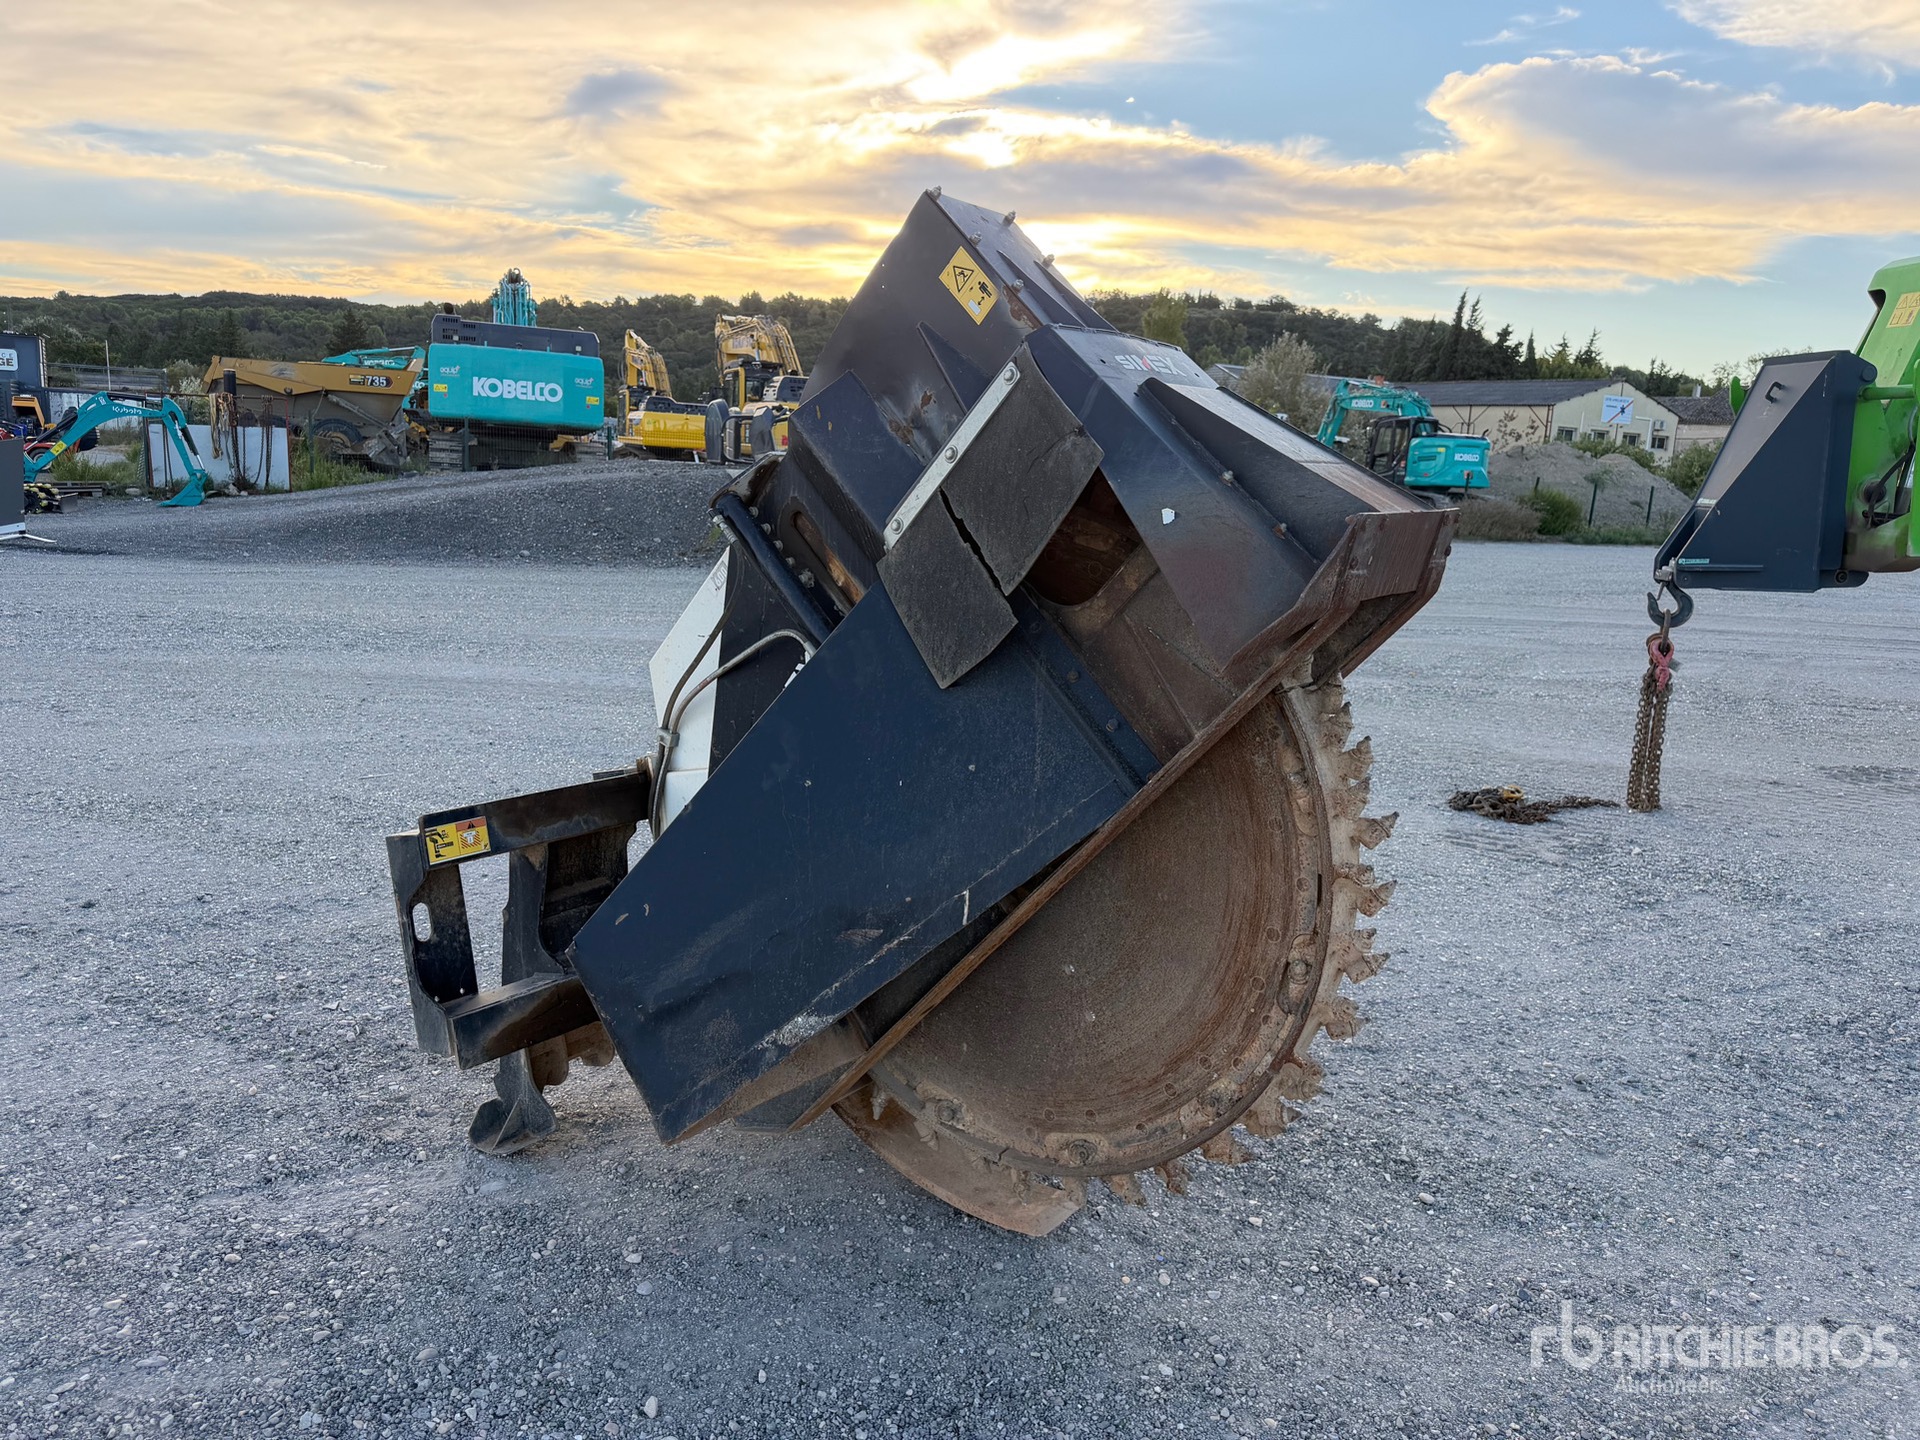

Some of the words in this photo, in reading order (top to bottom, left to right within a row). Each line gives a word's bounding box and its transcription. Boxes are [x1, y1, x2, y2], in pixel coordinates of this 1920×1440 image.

[1114, 354, 1187, 377] SIMEX
[366, 375, 387, 387] 735
[472, 376, 563, 403] KOBELCO
